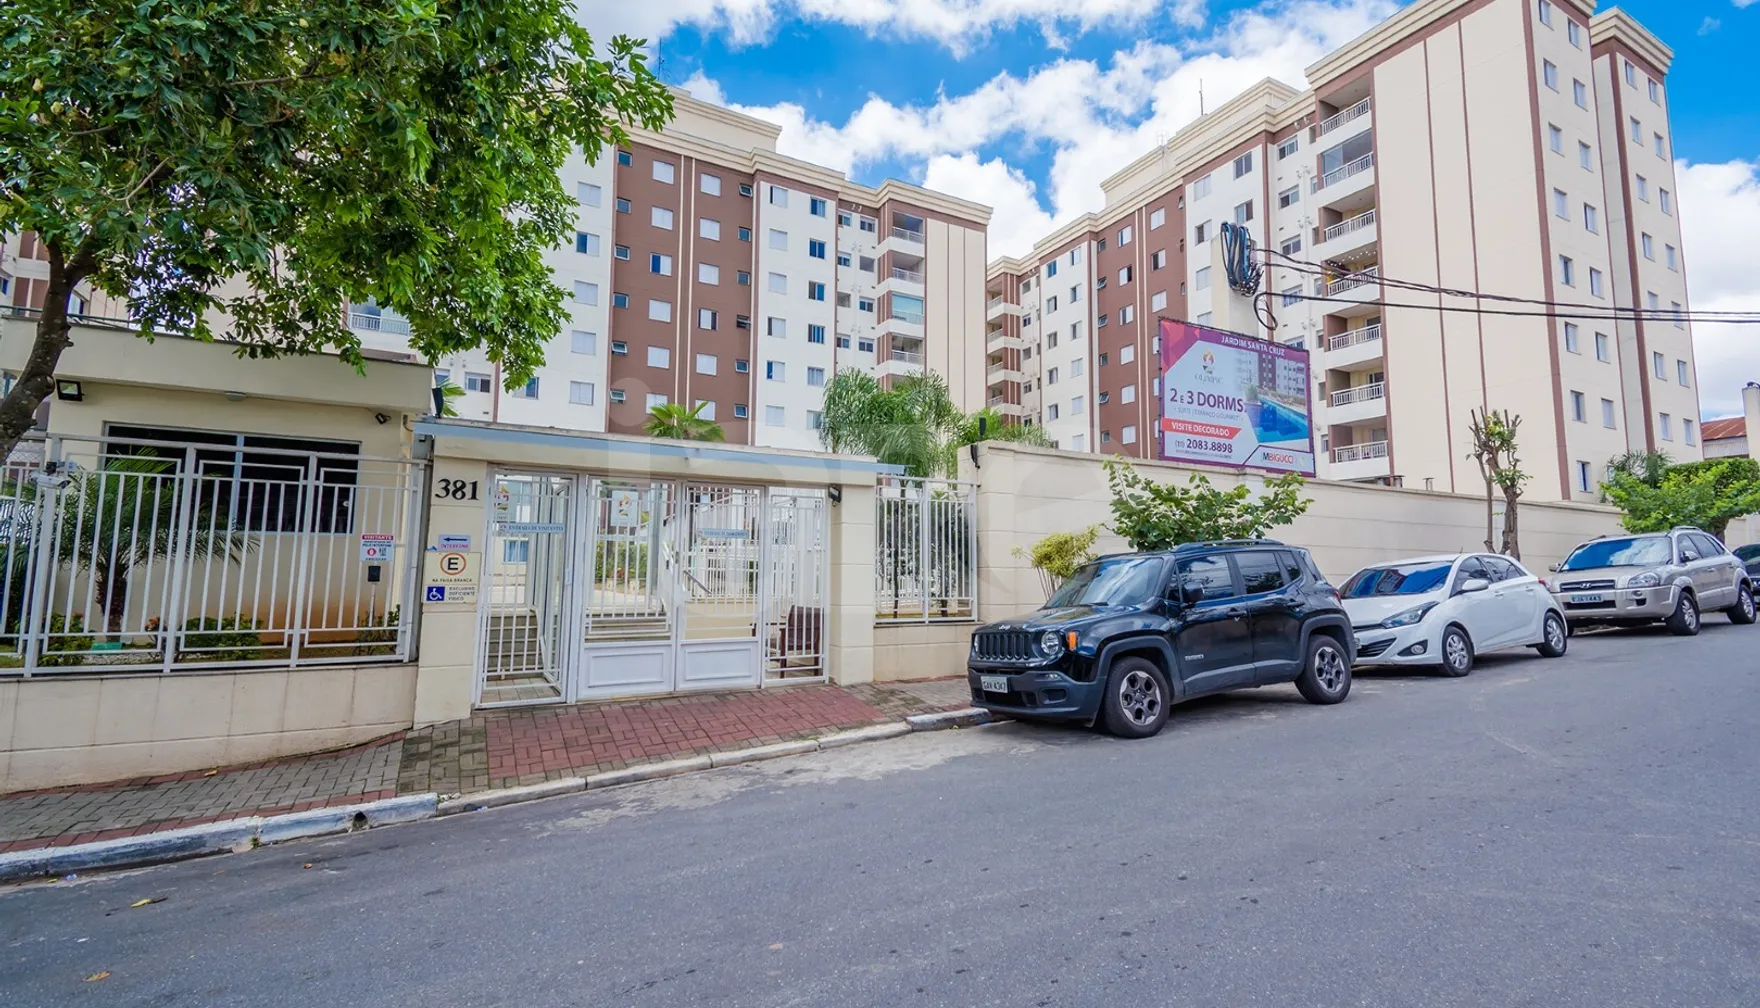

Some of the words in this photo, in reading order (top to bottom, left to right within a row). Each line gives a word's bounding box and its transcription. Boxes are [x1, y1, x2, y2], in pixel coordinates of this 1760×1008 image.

[1221, 336, 1248, 347] JARDIM
[1248, 341, 1268, 352] SANTA
[1269, 346, 1286, 356] CRUZ
[1170, 388, 1178, 402] 2
[1180, 395, 1184, 403] E
[1187, 390, 1194, 405] 3
[1171, 422, 1192, 431] VISITE
[1193, 425, 1230, 436] DECORADO
[1187, 438, 1233, 454] 2083.8898
[434, 478, 480, 501] 381
[447, 557, 459, 570] E
